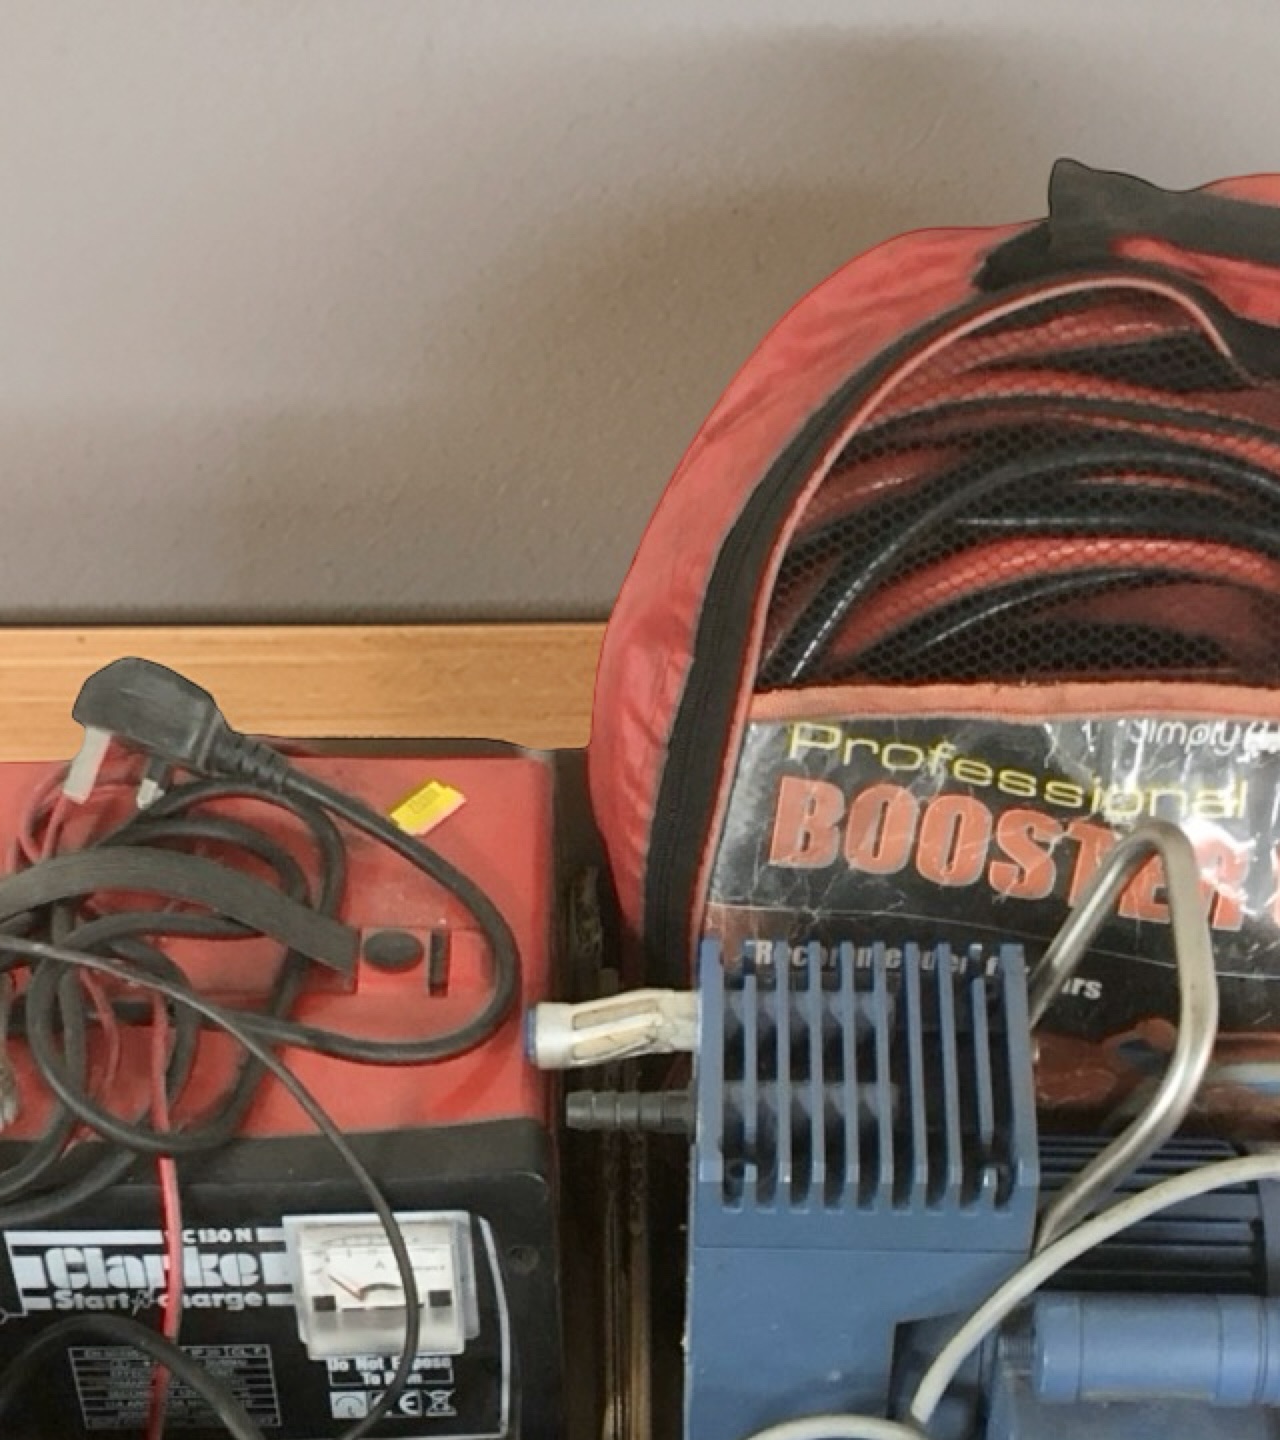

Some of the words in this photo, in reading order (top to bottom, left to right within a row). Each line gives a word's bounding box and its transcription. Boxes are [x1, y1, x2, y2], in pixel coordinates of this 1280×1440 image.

[786, 722, 1248, 819] Professional
[45, 1247, 262, 1289] Clarke
[53, 1288, 129, 1310] Start
[157, 1290, 264, 1311] carge
